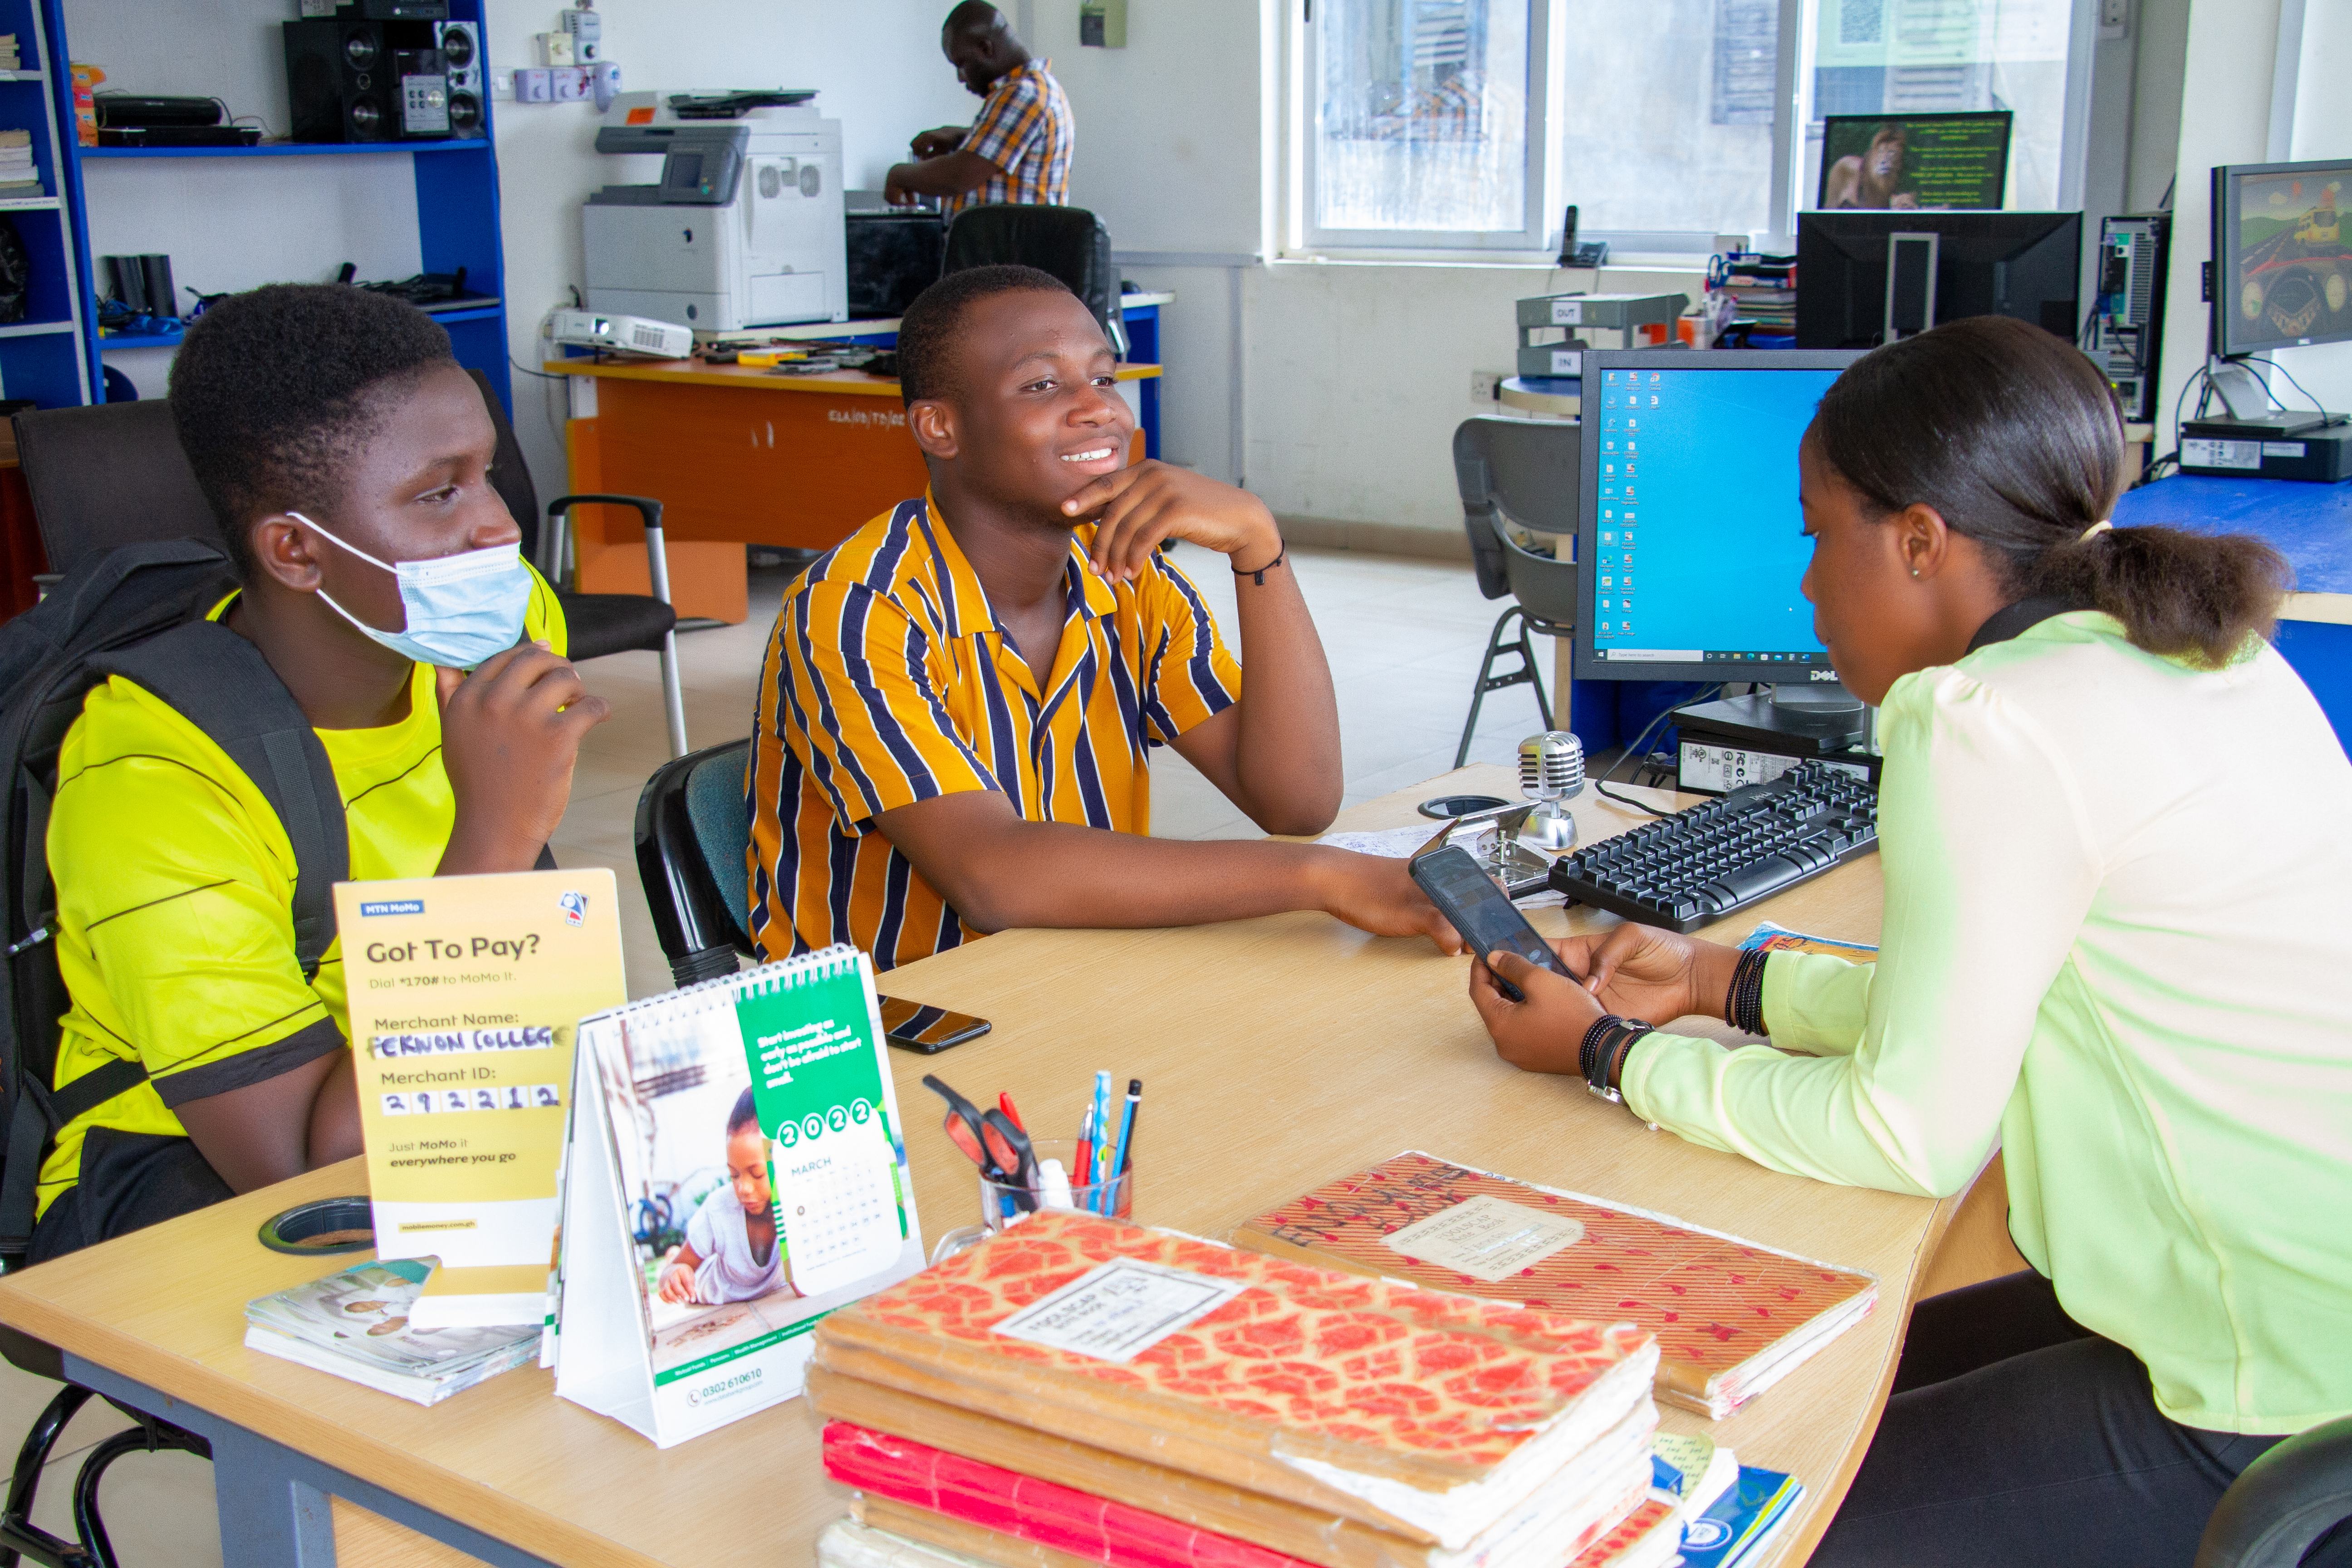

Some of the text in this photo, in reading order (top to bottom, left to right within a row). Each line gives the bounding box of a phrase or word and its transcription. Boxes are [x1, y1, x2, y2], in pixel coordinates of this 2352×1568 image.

[366, 902, 420, 914] MTN MoMo
[367, 934, 541, 963] Got To Pay?
[370, 977, 395, 989] Dial
[443, 975, 456, 985] to
[461, 973, 500, 984] MoMo
[375, 1013, 519, 1030] Merchant Name:
[757, 1032, 782, 1048] Start
[833, 1024, 852, 1040] and
[840, 1037, 862, 1052] start
[382, 1067, 496, 1085] Merchant ID:
[782, 1103, 868, 1145] 2022
[389, 1139, 468, 1152] Just MoMo it
[391, 1152, 516, 1167] everywhere you go
[791, 1157, 832, 1176] MARCH
[402, 1221, 475, 1231] mobilemoney.com.gh
[1435, 1214, 1491, 1240] FOOLSCAP
[1448, 1218, 1505, 1243] Note Book
[703, 1367, 762, 1398] 0302 610610
